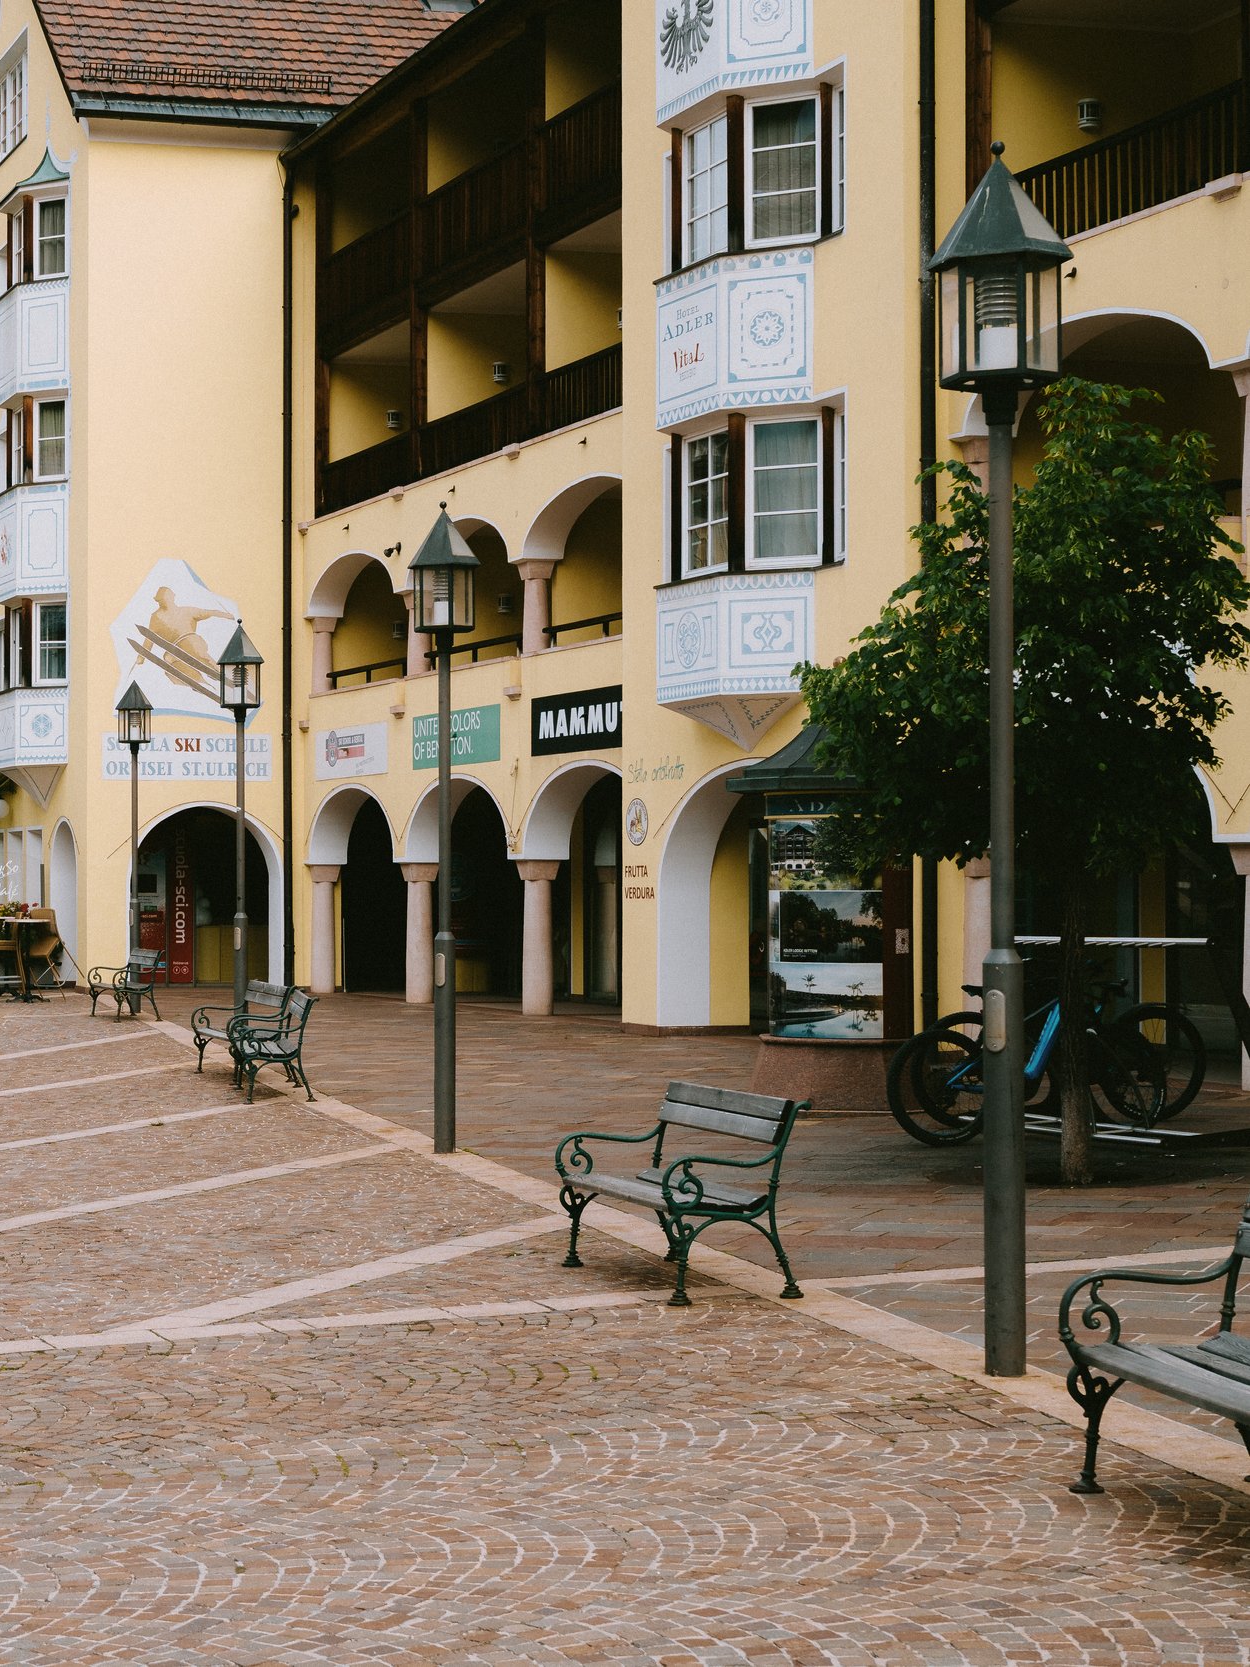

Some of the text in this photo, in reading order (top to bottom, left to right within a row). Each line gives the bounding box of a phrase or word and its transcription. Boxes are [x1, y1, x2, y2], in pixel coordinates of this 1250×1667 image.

[662, 312, 713, 342] ADLER
[413, 710, 481, 738] UNITE OLORS
[538, 700, 622, 740] MAMMU
[174, 737, 201, 752] SKI
[413, 742, 425, 761] OF
[106, 760, 268, 777] ORISEI ST.ULRCH
[624, 865, 648, 878] FRUTTA
[624, 887, 654, 899] VERDURA
